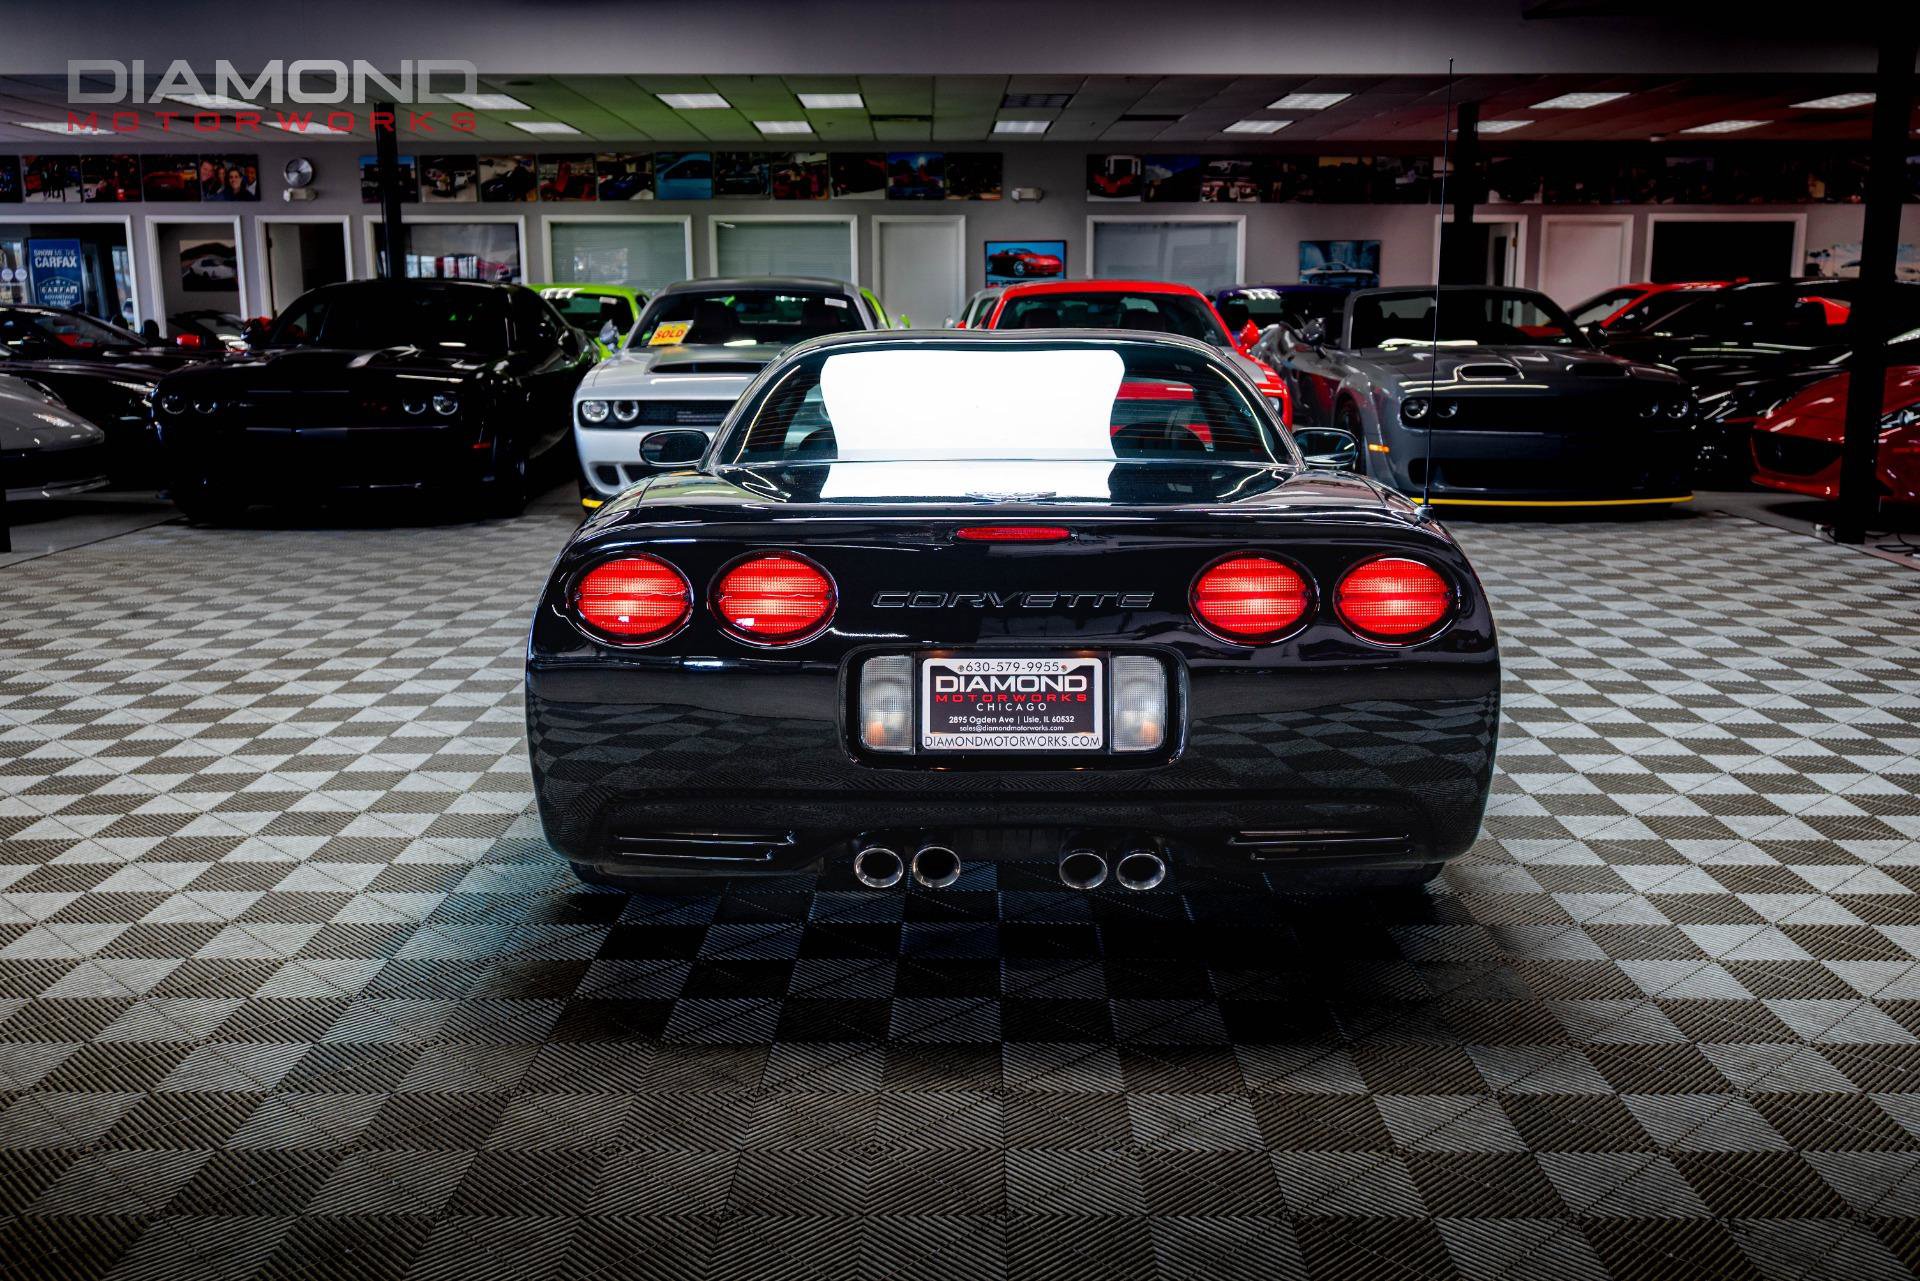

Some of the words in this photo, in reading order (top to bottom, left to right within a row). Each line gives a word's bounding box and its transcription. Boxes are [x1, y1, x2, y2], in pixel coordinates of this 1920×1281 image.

[35, 256, 77, 268] CARFAX
[655, 329, 684, 338] SOLD
[871, 591, 1155, 608] CORVETTE
[965, 661, 1060, 672] 630-579-9955
[935, 675, 1087, 692] DIAMOND
[935, 693, 1087, 703] MOTORWORKS
[976, 703, 1047, 712] CHICAGO
[948, 716, 968, 724] 2895
[969, 716, 997, 725] Ogden
[999, 716, 1014, 724] Ave
[1023, 716, 1042, 725] Lisle,
[1043, 716, 1050, 724] IL
[1051, 716, 1075, 724] 60532
[924, 736, 1101, 747] DIAMONDMOTORWORKS.COM
